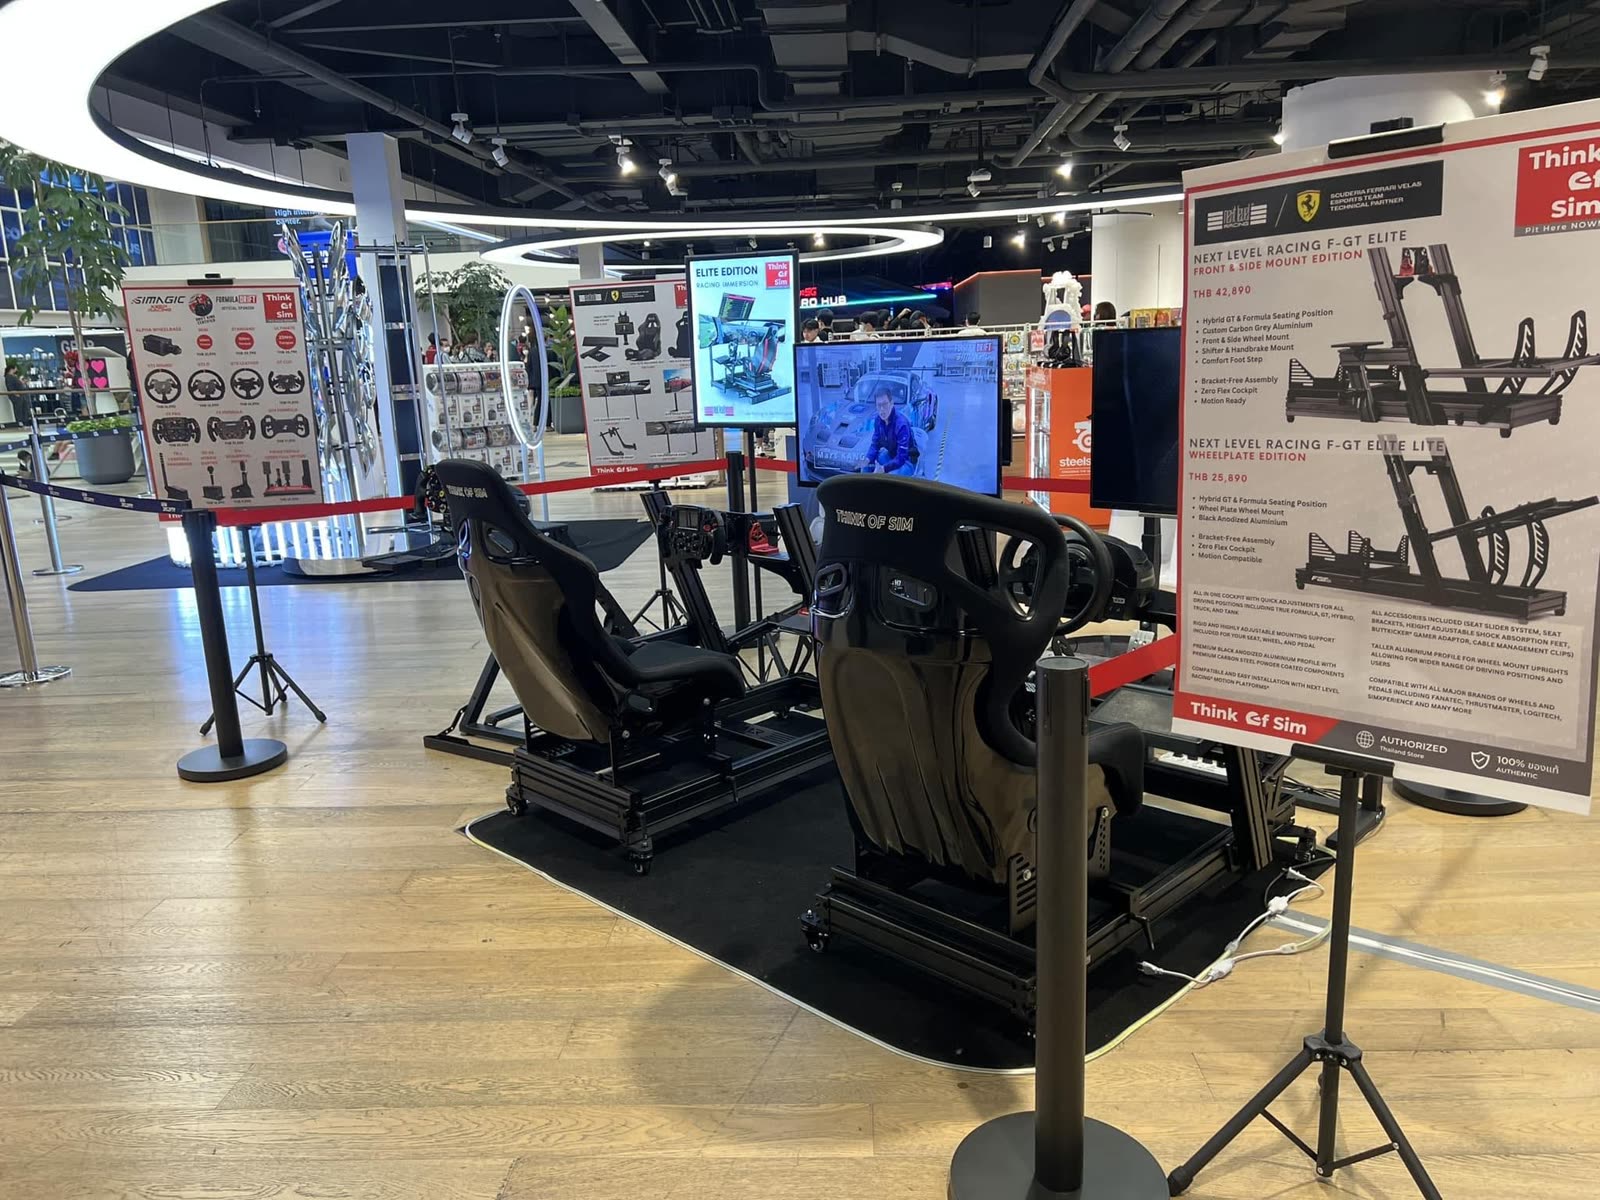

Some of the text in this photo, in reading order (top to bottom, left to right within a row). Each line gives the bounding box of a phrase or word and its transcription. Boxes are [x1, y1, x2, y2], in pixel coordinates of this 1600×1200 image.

[1331, 181, 1422, 199] SCUDERIA FERRARI VELAS
[1330, 196, 1362, 205] ESPORTS
[1330, 197, 1404, 211] TECHNICAL PARTNER
[1551, 197, 1600, 218] Sim
[1194, 230, 1407, 264] NEXT LEVEL RACING F-GT ELITE
[1194, 250, 1363, 276] FRONT & SIDE MOUNT EDITION
[696, 266, 758, 277] ELITE EDITION
[1194, 286, 1251, 298] THB 42,890
[132, 296, 186, 304] SIMAGIC
[821, 295, 847, 306] HUB
[1203, 316, 1224, 325] Hybrid
[1273, 311, 1300, 320] Seating
[1302, 309, 1333, 317] Position
[1255, 324, 1271, 333] Grey
[1273, 322, 1313, 330] Aluminium
[1244, 376, 1278, 384] Assembly
[1189, 438, 1445, 451] NEXT LEVEL RACING F-GT ELITE LITE
[1189, 451, 1306, 462] WHEELPLATE EDITION
[1189, 473, 1248, 483] THB 25,890
[1200, 495, 1221, 504] Hybrid
[1239, 497, 1267, 505] Formula
[1269, 498, 1296, 508] Seating
[1297, 499, 1327, 508] Position
[836, 509, 914, 532] THINK OF SIM
[1218, 515, 1248, 523] Anodized
[1250, 517, 1288, 526] Aluminium
[1198, 533, 1275, 546] Bracket-Free Assembly
[1228, 545, 1255, 554] Cockpit
[1221, 554, 1262, 564] Compatible
[1191, 702, 1238, 722] Think
[1273, 716, 1307, 736] Sim
[1380, 735, 1448, 754] AUTHORIZED
[1380, 745, 1424, 760] Thailand Store
[1497, 754, 1526, 769] 100%
[1495, 767, 1538, 780] AUTHENTIC
